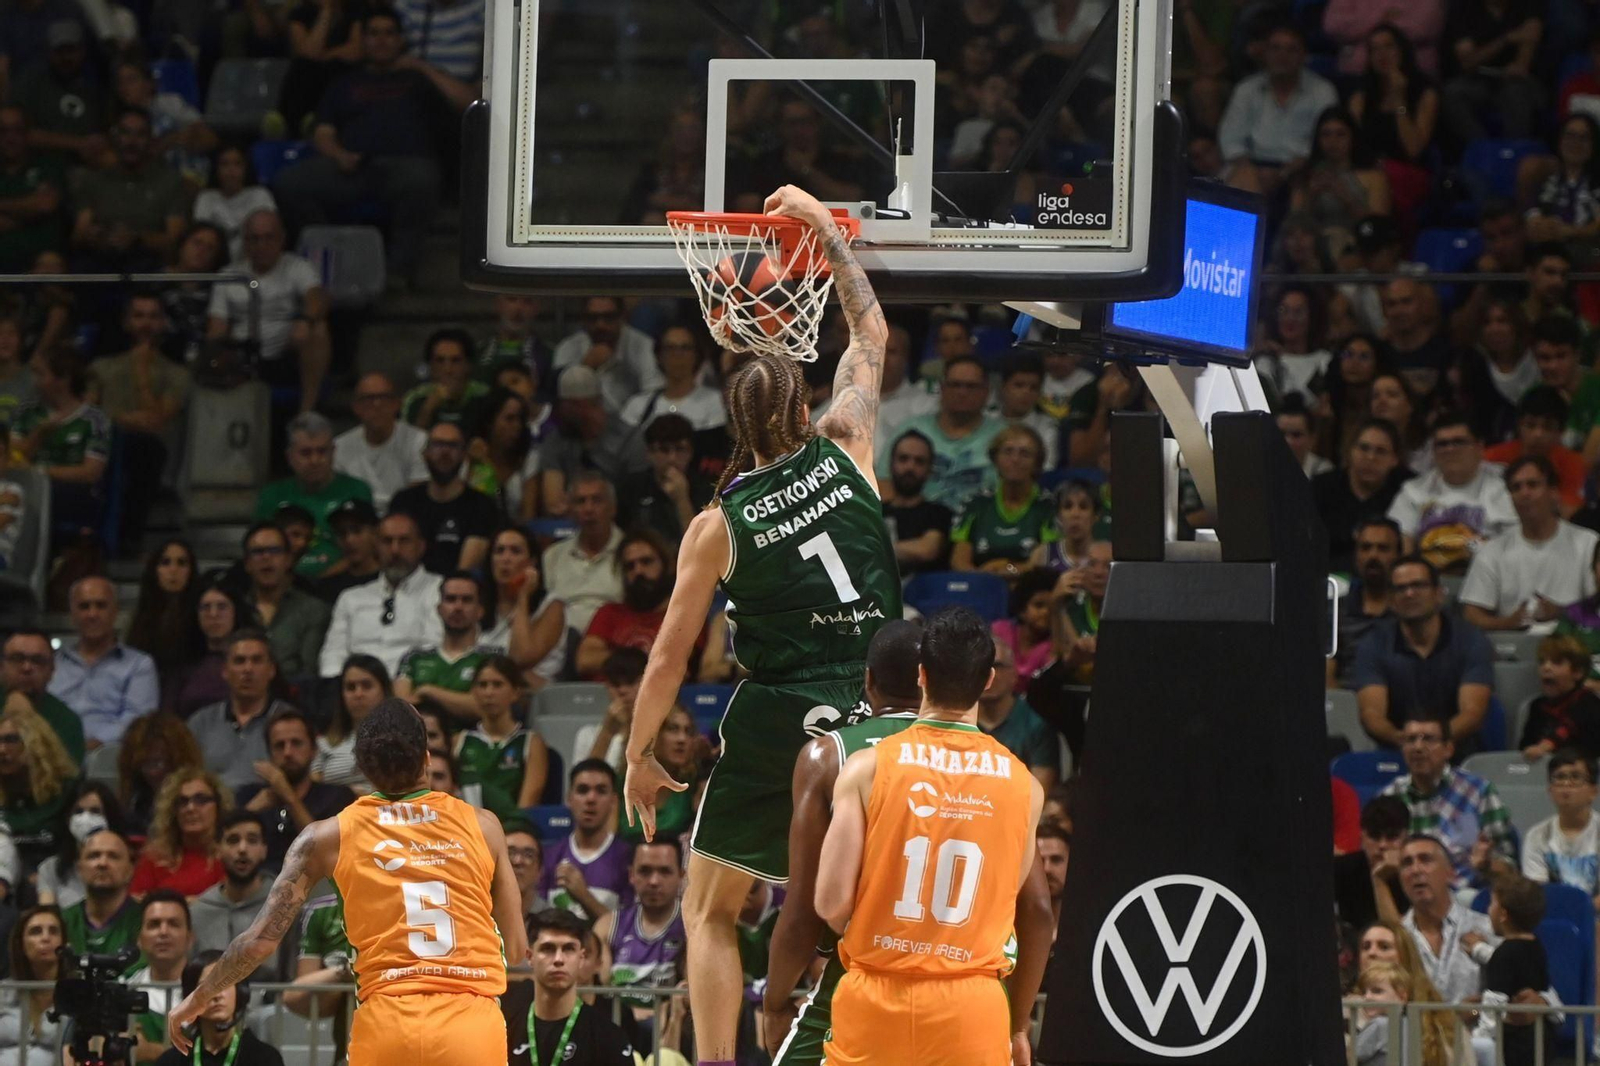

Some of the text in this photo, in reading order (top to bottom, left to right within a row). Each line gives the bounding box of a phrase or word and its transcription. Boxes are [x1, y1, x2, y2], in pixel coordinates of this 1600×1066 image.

[1038, 192, 1070, 210] liga
[1038, 209, 1106, 225] endesa
[743, 456, 840, 523] OSETKOWSKI
[753, 484, 854, 550] BENAHAVÍS
[797, 530, 861, 604] 1
[809, 601, 886, 630] Andalucía
[898, 742, 1012, 779] ALMAZÁN
[375, 802, 439, 826] HILL
[941, 791, 995, 810] Andalucía
[409, 838, 464, 853] Andalucía
[893, 835, 985, 928] 10
[401, 880, 457, 960] 5
